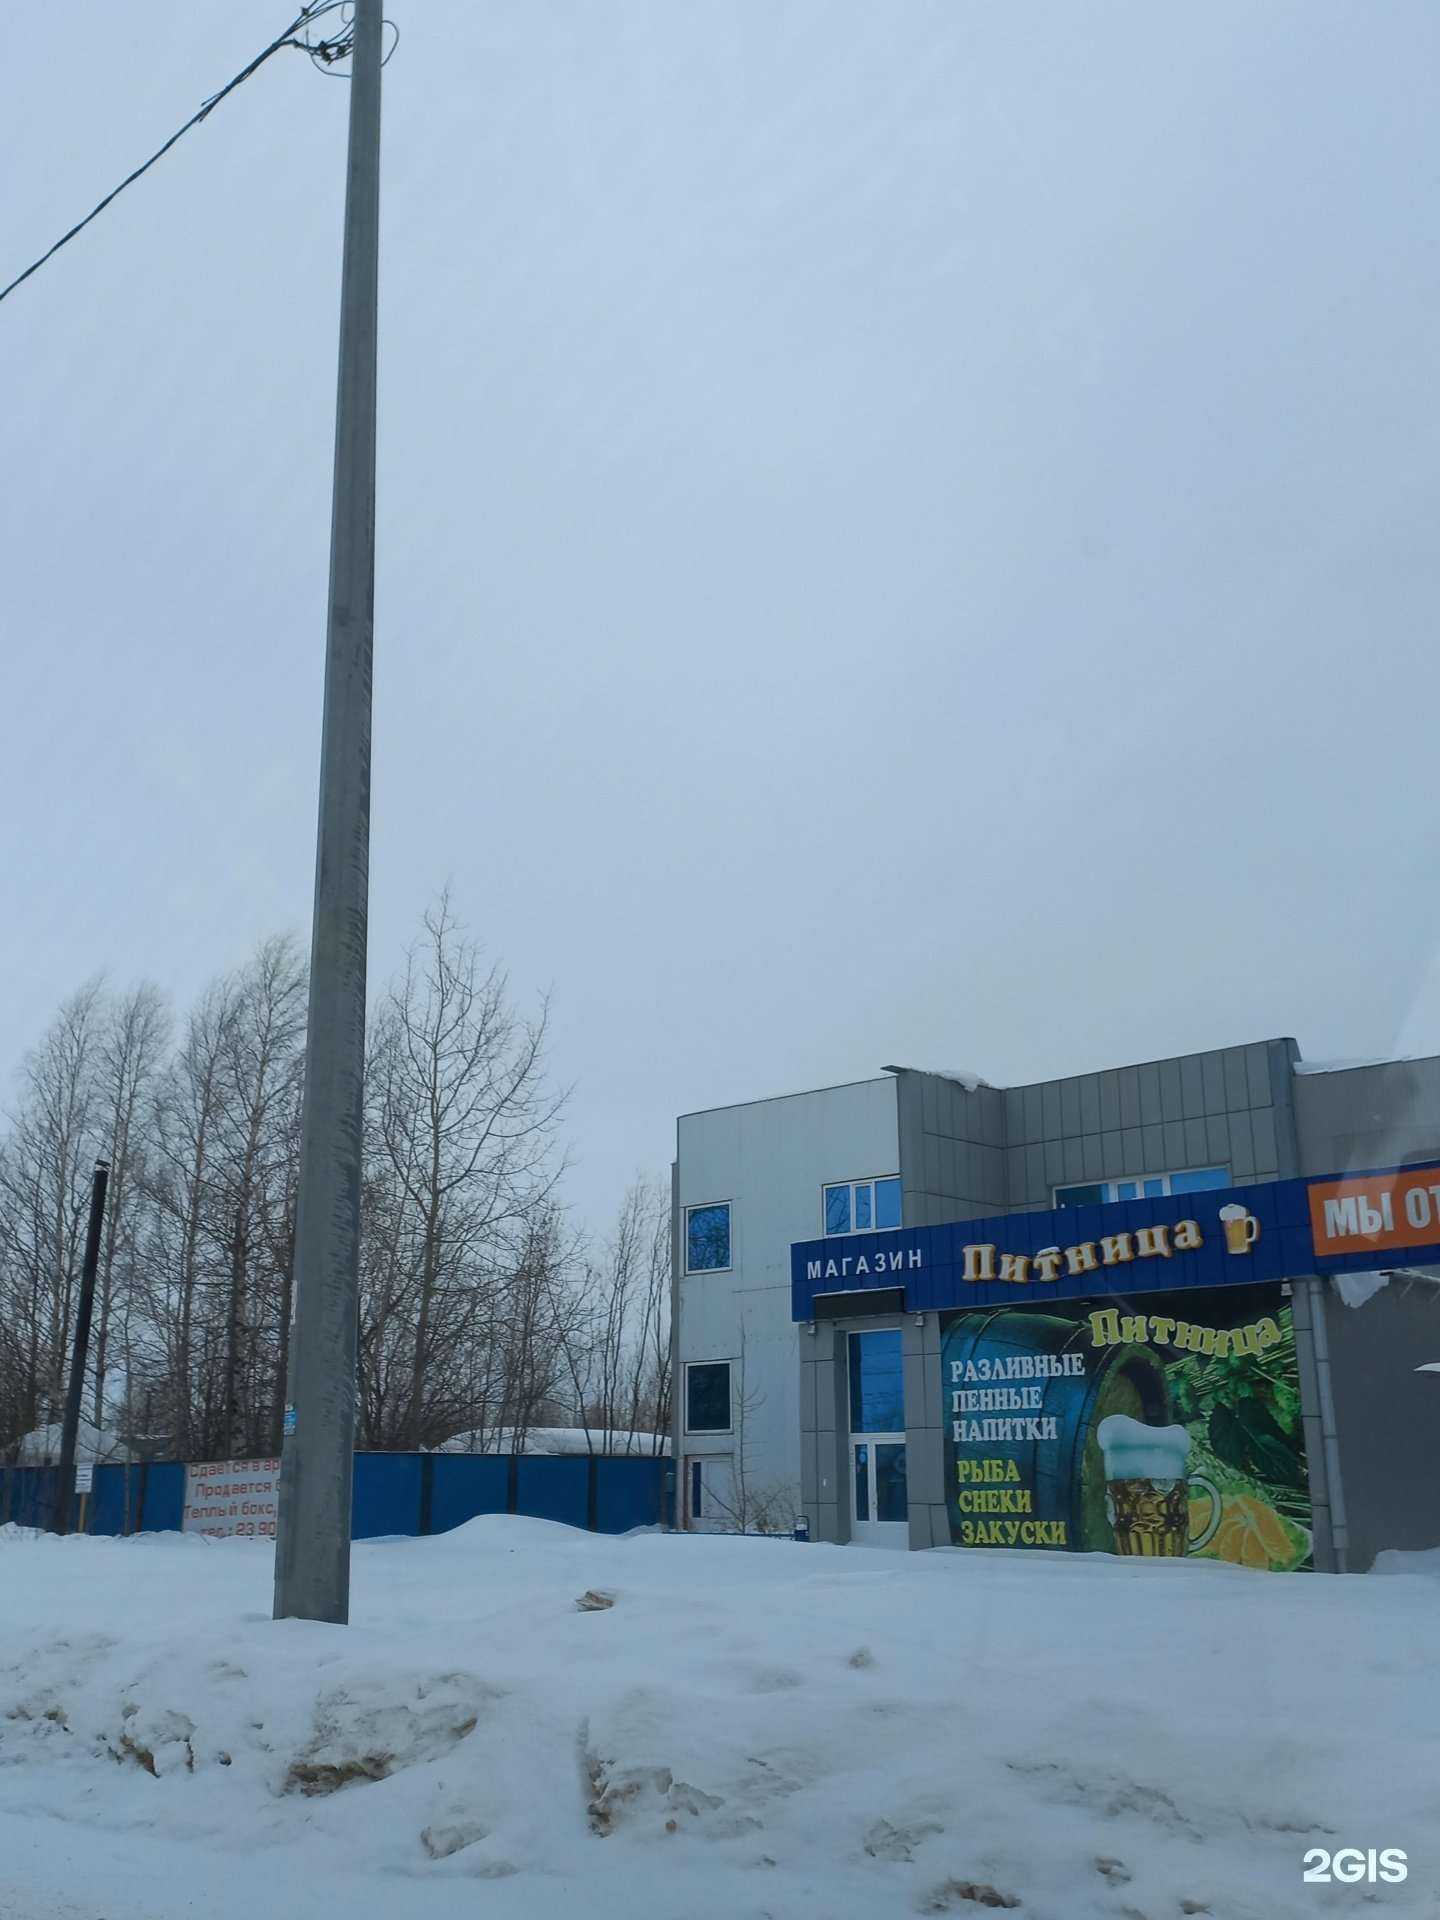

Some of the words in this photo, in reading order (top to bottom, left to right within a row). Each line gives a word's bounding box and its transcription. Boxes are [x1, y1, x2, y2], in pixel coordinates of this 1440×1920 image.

[1324, 1192, 1394, 1238] МЫ
[807, 1249, 922, 1279] МАГАЗИН
[962, 1219, 1204, 1283] Питница
[1089, 1308, 1282, 1358] Питница
[950, 1353, 1086, 1382] РАЗЛИВНЫЕ
[952, 1386, 1043, 1412] ПЕННЫЕ
[952, 1417, 1058, 1442] НАПИТКИ
[957, 1459, 1021, 1483] РЫБА
[959, 1489, 1032, 1513] СНЕКИ
[236, 1522, 254, 1536] 23
[961, 1520, 1067, 1545] ЗАКУСКИ
